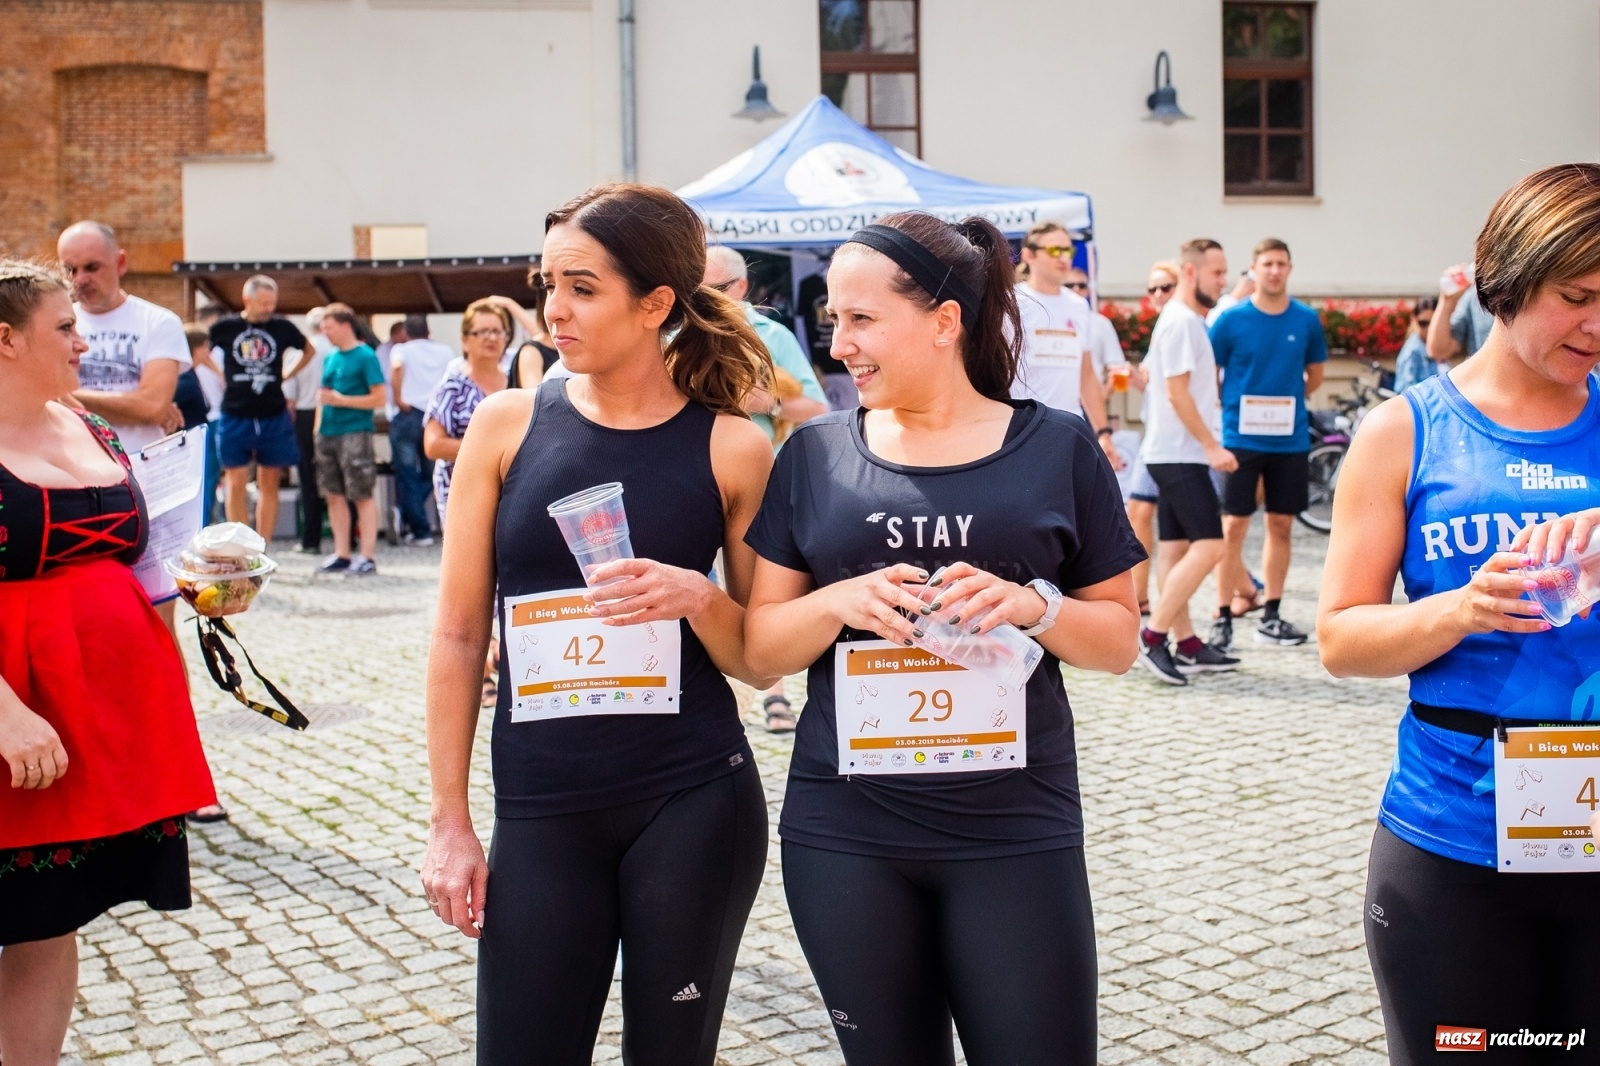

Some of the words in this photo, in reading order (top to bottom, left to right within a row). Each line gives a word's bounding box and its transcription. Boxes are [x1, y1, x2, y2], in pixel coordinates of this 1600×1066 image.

[708, 217, 780, 238] LĄSKI
[80, 331, 140, 343] NTOWN
[1505, 458, 1554, 478] eko
[865, 512, 886, 523] 4F
[886, 514, 974, 549] STAY
[529, 611, 533, 619] I
[535, 608, 557, 619] Bieg
[562, 635, 606, 666] 42
[867, 661, 871, 669] I
[875, 659, 899, 670] Bieg
[903, 657, 941, 668] Wokół
[552, 681, 587, 690] 03.08.2019
[589, 679, 620, 688] Racibórz
[908, 689, 953, 723] 29
[895, 738, 935, 746] 03.08.2019
[936, 737, 969, 745] Racibórz
[1529, 743, 1533, 752] I
[1538, 742, 1567, 754] Bieg
[1572, 741, 1600, 752] Wok
[672, 991, 701, 1001] adidas
